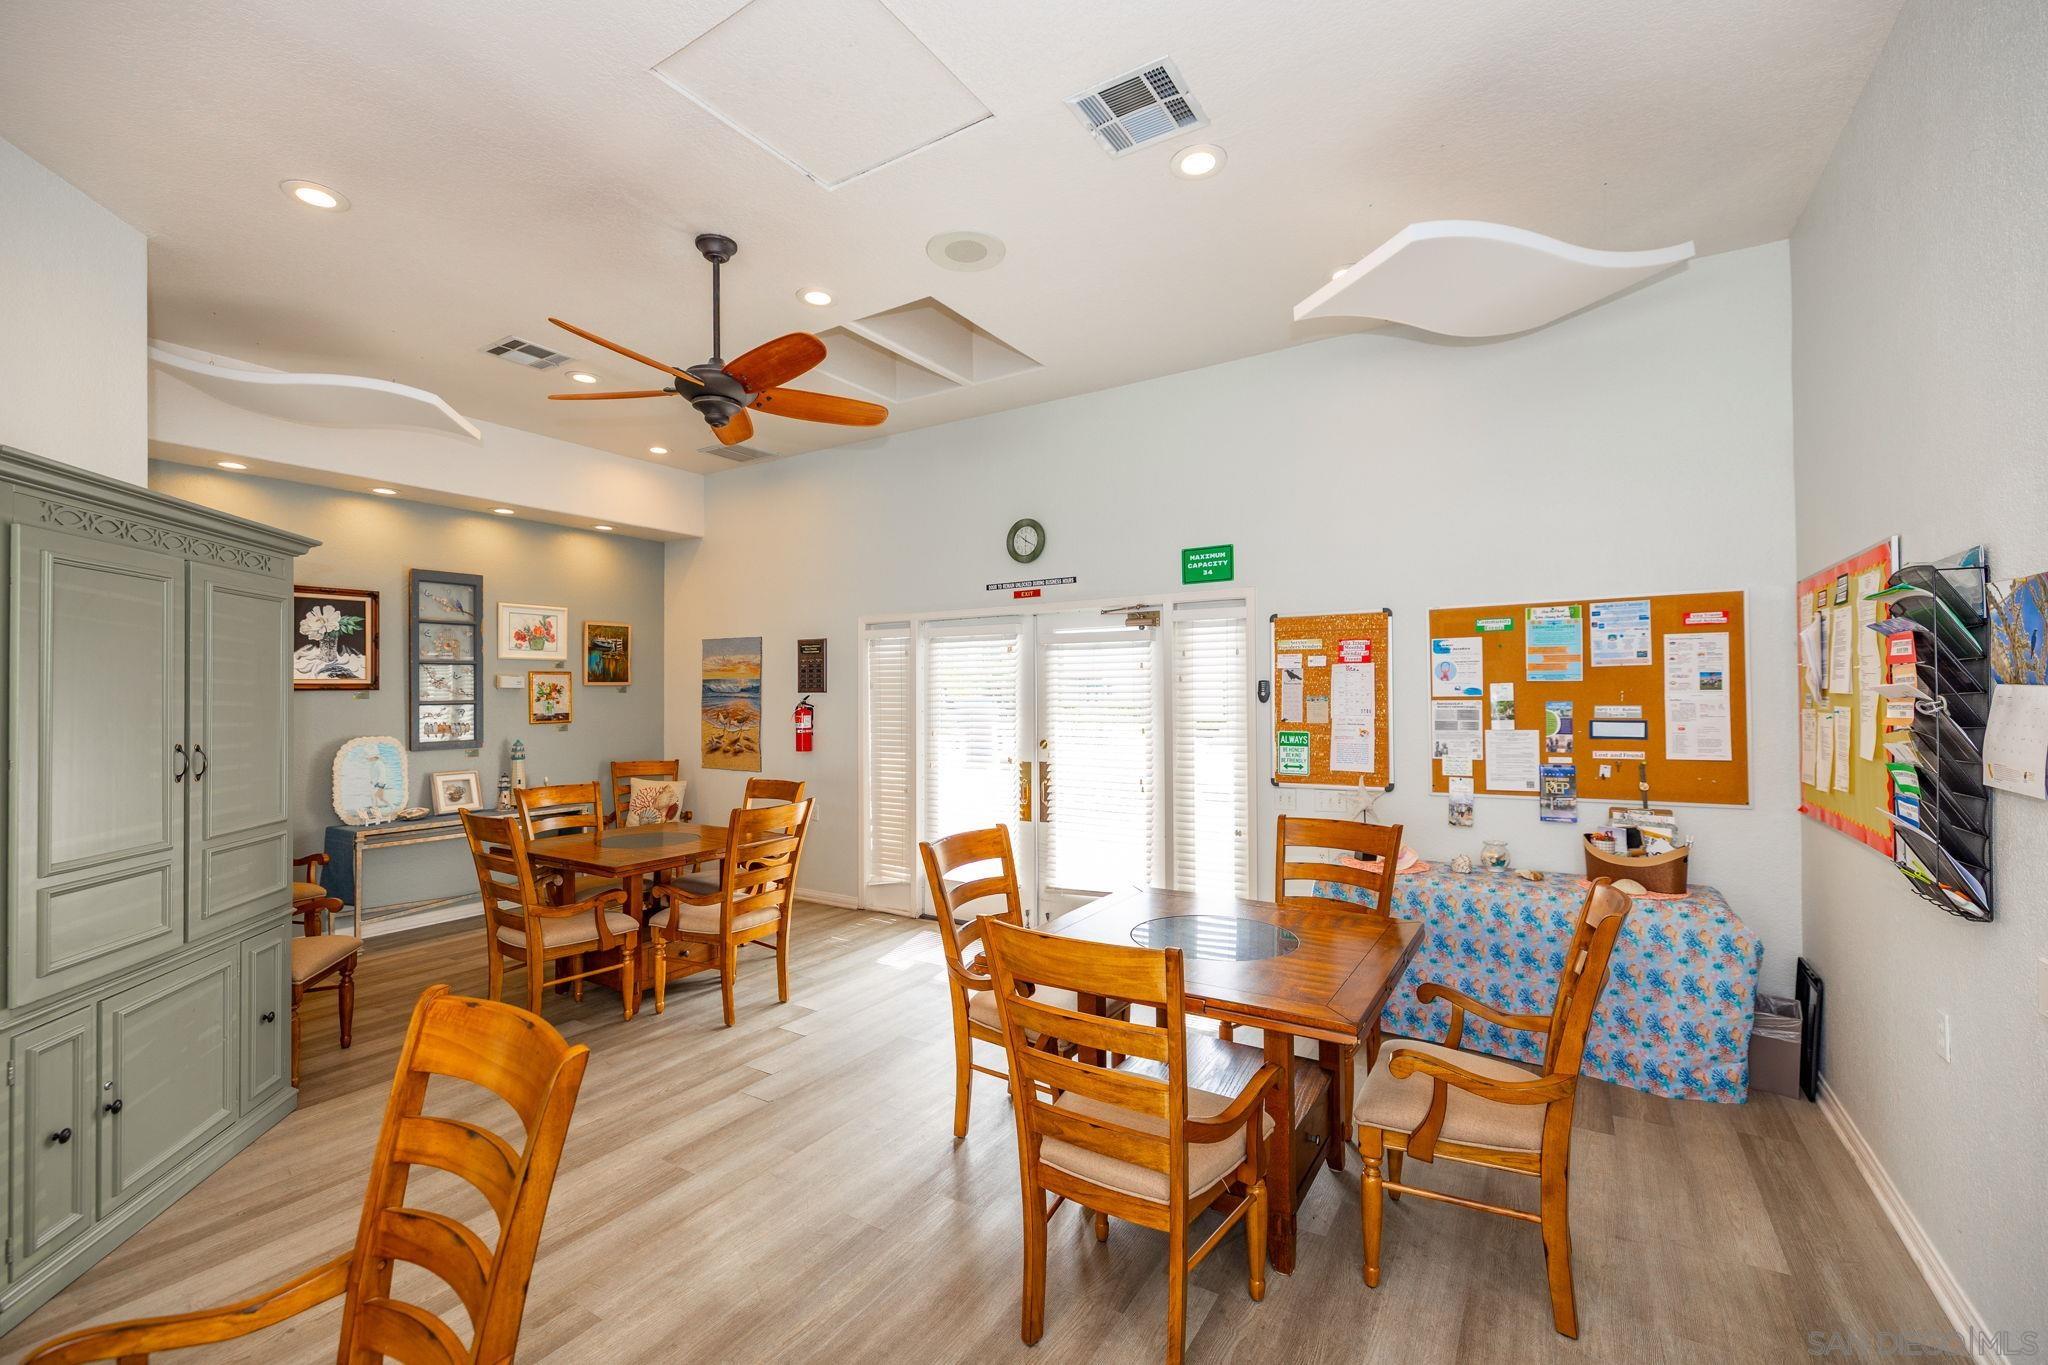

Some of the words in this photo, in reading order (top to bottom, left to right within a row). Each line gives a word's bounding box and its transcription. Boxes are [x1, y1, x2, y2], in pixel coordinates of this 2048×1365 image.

[1190, 552, 1226, 561] MAXIMUM
[1187, 560, 1228, 569] CAPACITY
[1281, 735, 1308, 745] ALWAYS
